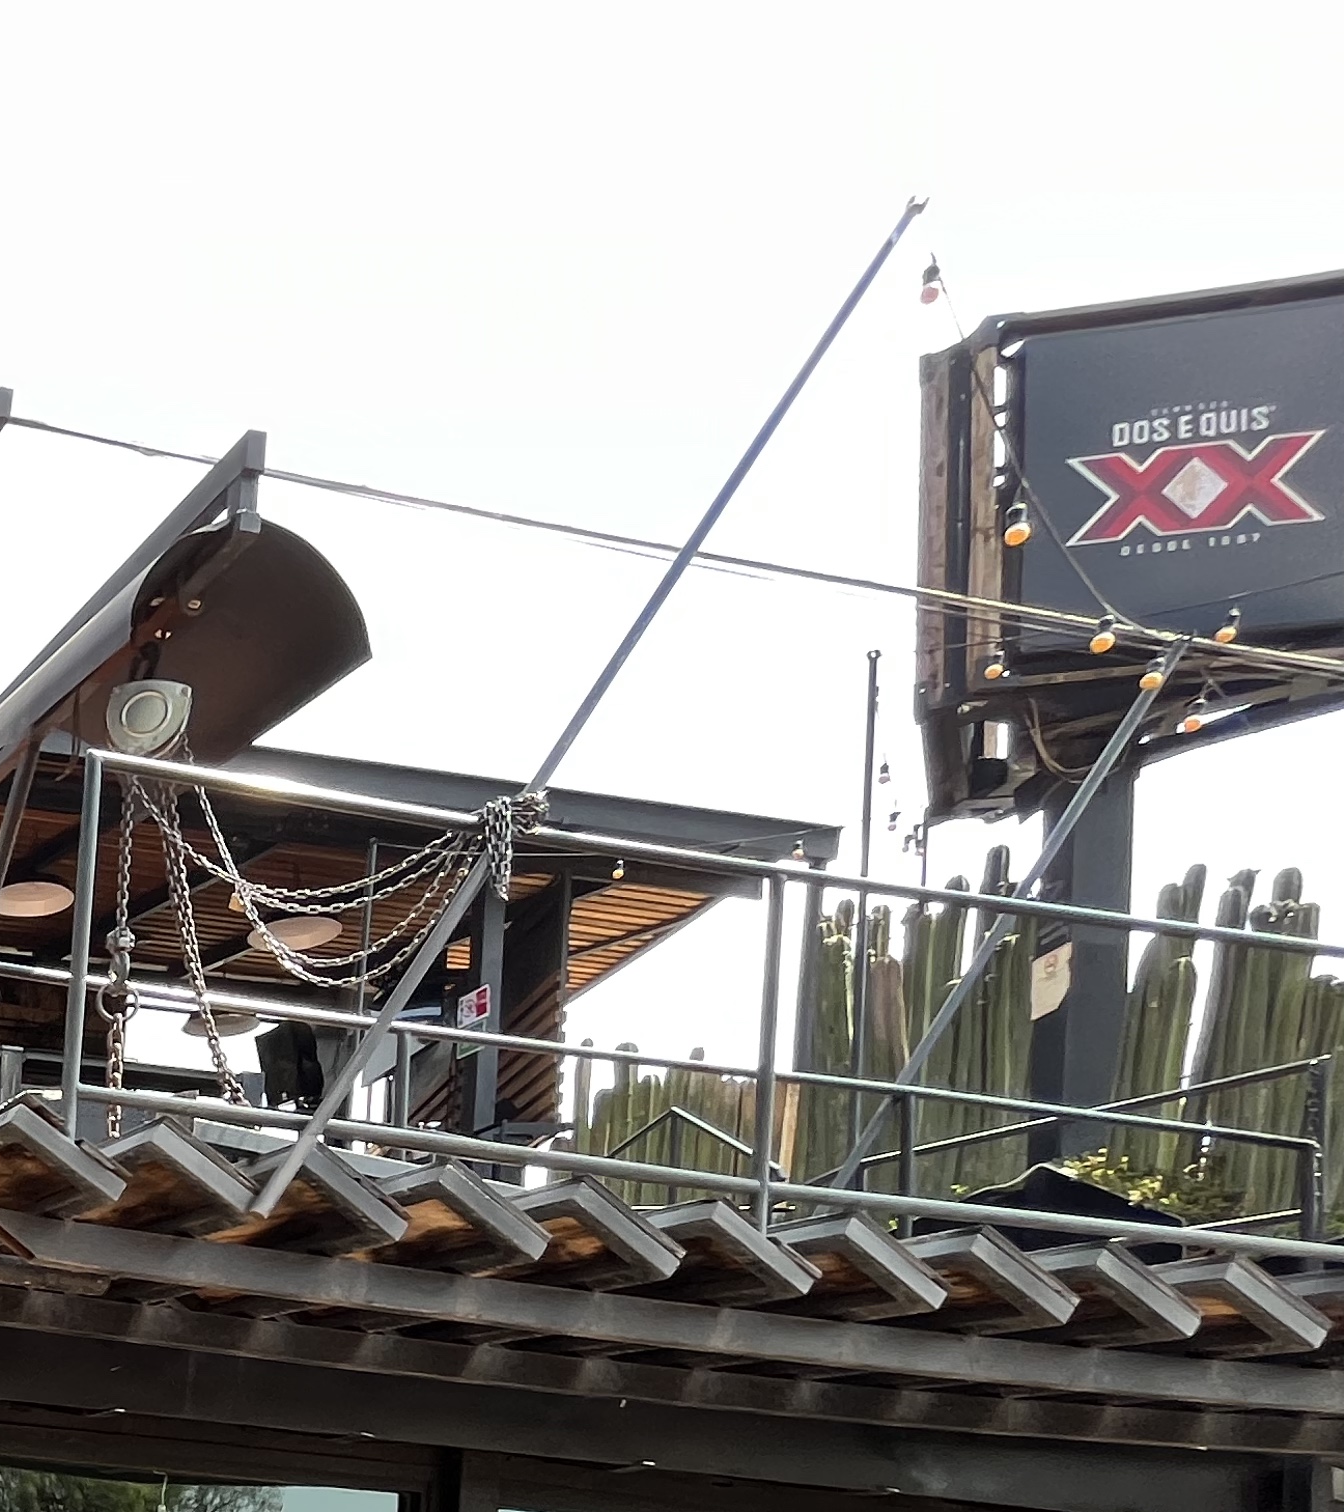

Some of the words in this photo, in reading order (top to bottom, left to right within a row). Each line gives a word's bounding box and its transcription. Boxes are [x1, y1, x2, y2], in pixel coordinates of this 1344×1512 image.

[1112, 417, 1172, 447] DOS
[1177, 414, 1194, 440] E
[1199, 406, 1269, 437] QUIS
[1065, 429, 1327, 547] XX
